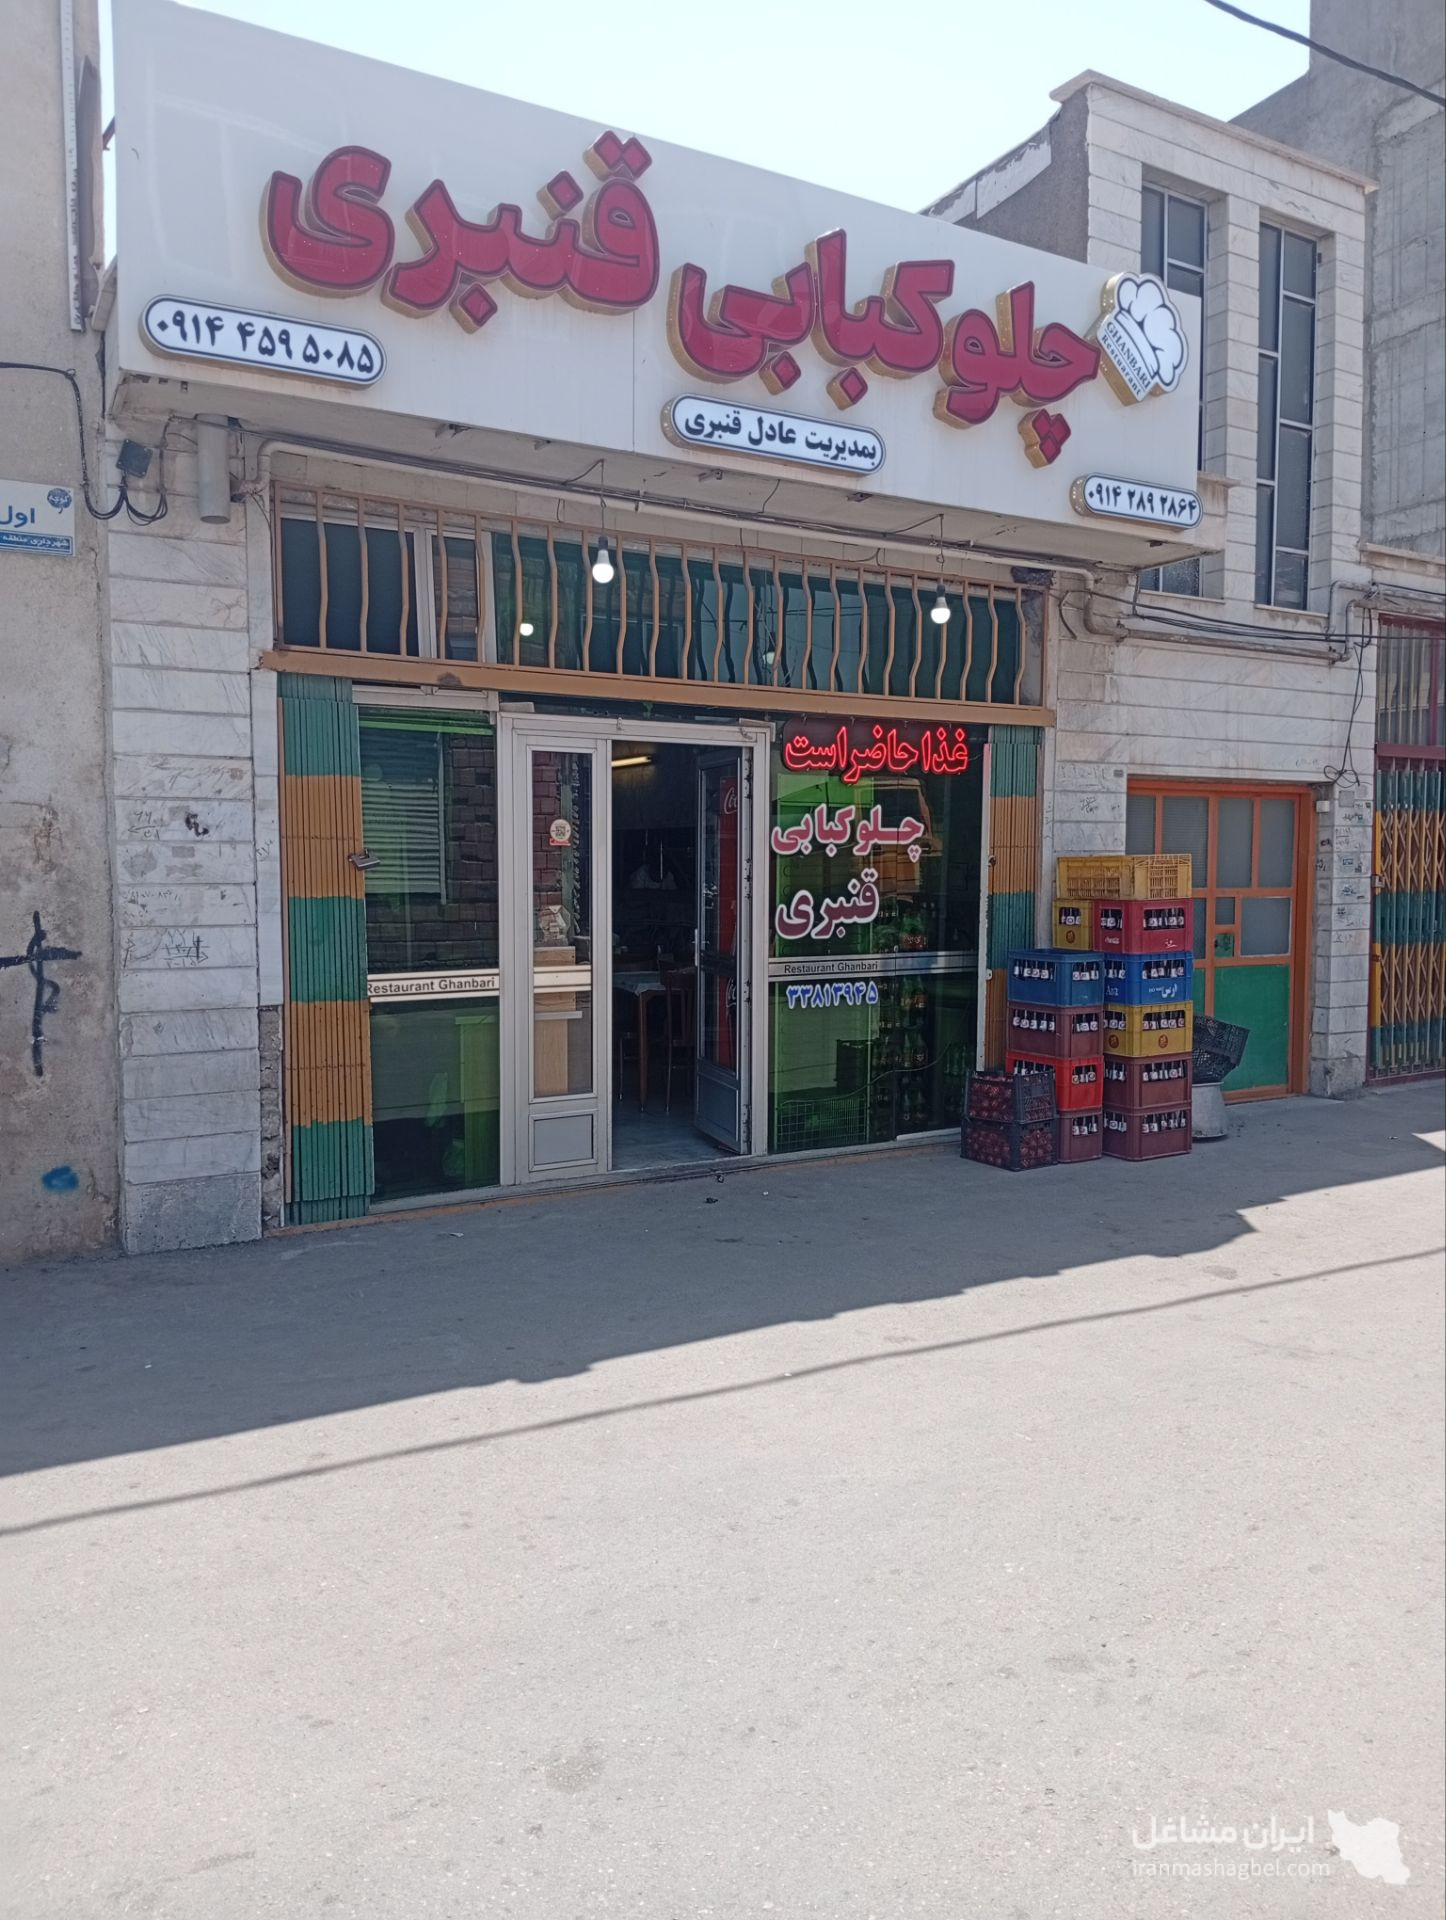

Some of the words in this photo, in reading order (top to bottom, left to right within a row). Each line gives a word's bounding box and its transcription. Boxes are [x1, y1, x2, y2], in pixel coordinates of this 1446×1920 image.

[264, 130, 660, 331] قنبری
[157, 310, 224, 346] ۰۹۱۴
[236, 321, 293, 360] ۴۵۹
[302, 334, 374, 374] ۵۰۸۵
[1106, 321, 1151, 389] GHANBARI
[685, 410, 742, 438] قنبری
[748, 416, 796, 446] عادل
[805, 431, 876, 466] بمدیریت
[1088, 483, 1122, 507] ۰۹۱۴
[775, 867, 880, 940] قنبری
[784, 963, 835, 974] Restaurant
[838, 960, 878, 972] Ghanbari
[438, 977, 495, 990] Ghanbari
